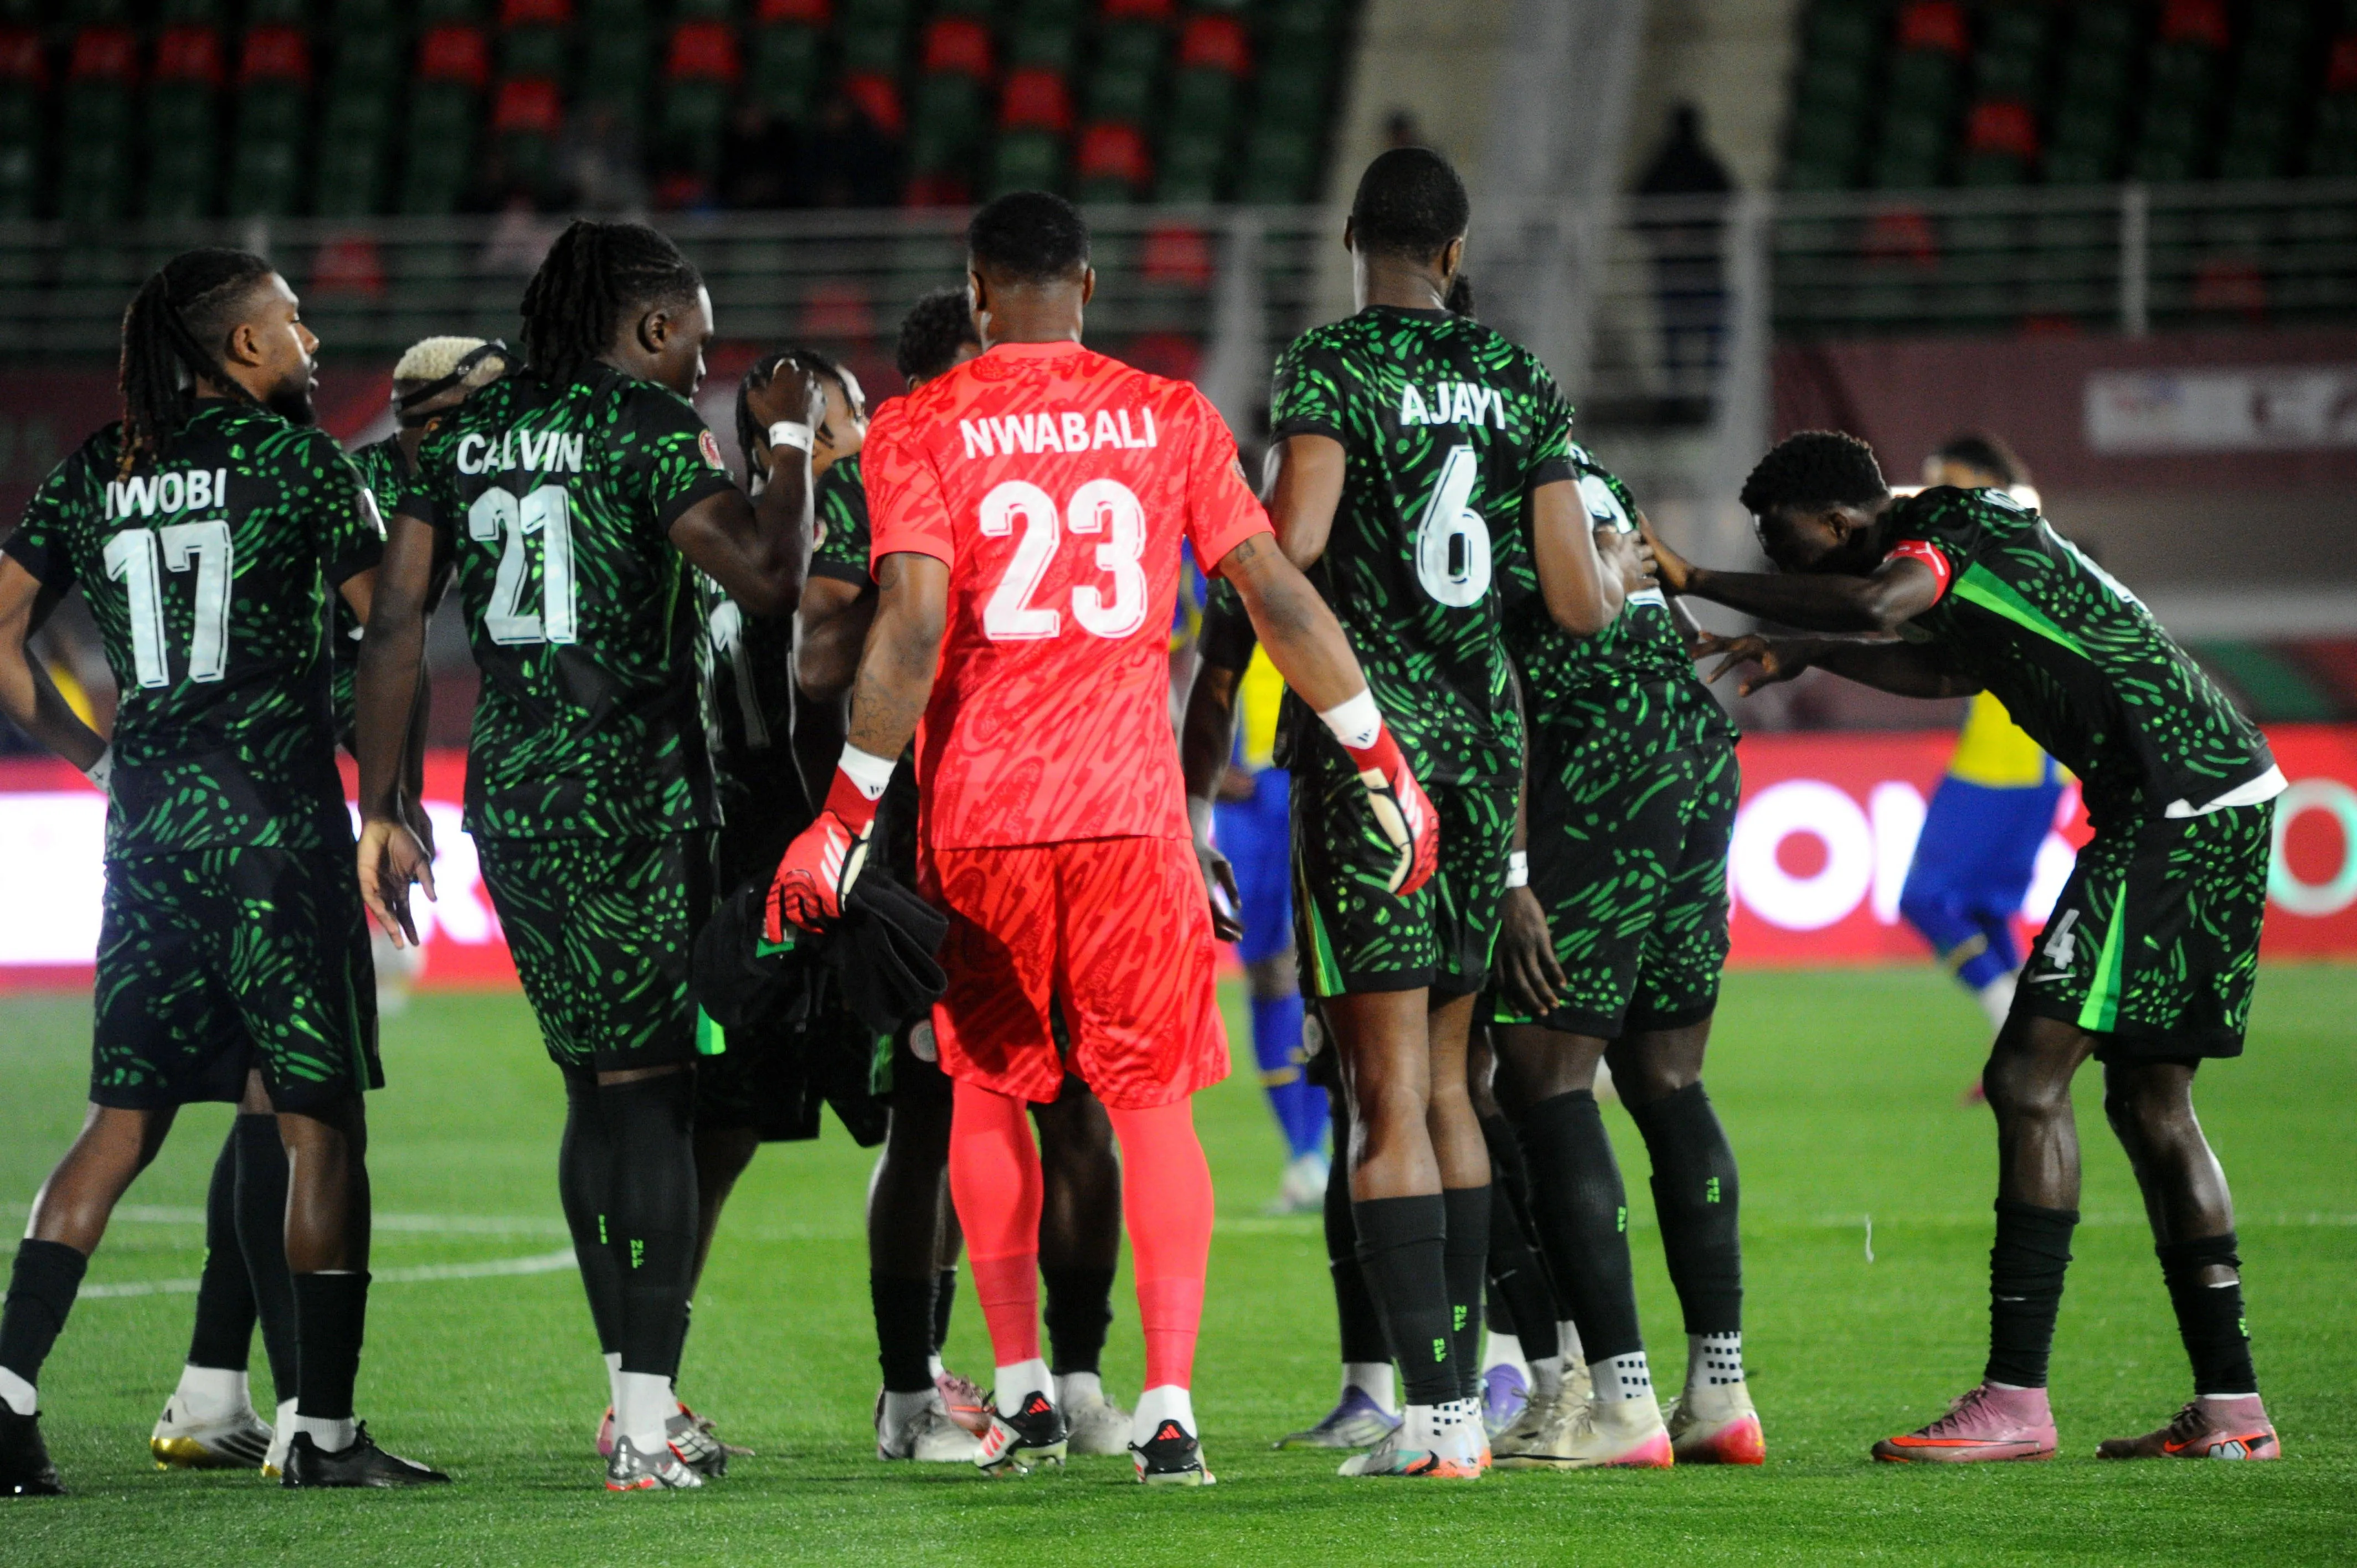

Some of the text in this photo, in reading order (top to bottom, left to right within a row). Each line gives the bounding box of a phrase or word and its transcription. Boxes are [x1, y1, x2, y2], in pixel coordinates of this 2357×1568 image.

[960, 407, 1157, 459] NWABALI
[1400, 380, 1506, 430] AJAYI
[457, 429, 583, 474] CALVIN
[106, 468, 227, 520] IWOBI
[1416, 444, 1491, 607] 6
[469, 485, 578, 646] 21
[979, 478, 1147, 641] 23
[103, 519, 234, 688] 17
[2043, 908, 2080, 969] 4
